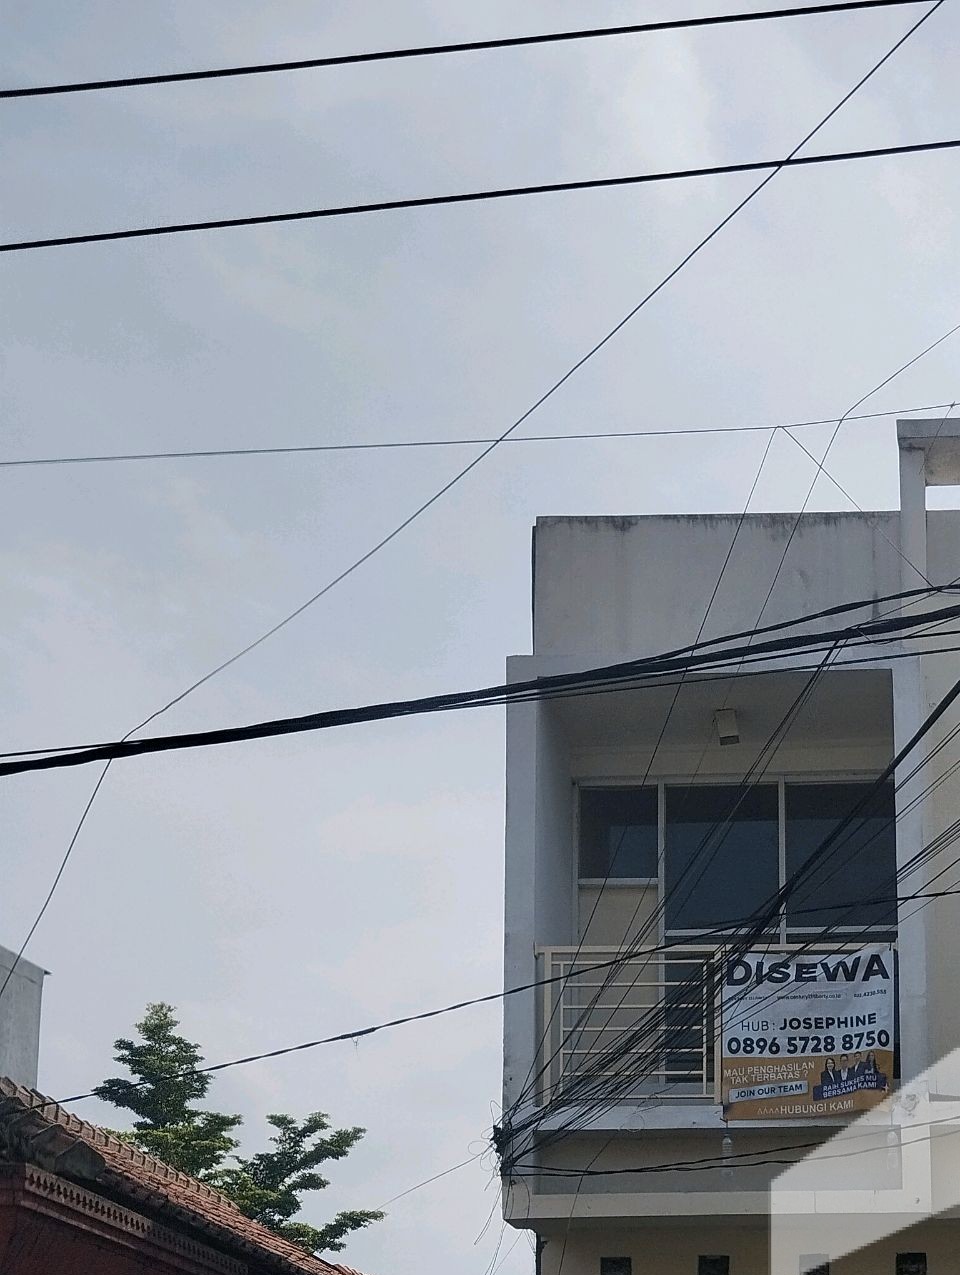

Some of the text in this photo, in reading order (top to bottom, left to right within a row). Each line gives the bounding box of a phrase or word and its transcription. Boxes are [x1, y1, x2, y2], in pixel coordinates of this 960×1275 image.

[726, 953, 890, 986] DISEWA
[779, 1013, 877, 1031] JOSEPHINE
[727, 1030, 890, 1055] 0896 5728 8750
[724, 1061, 815, 1078] MAU PENGHASILAN
[731, 1075, 749, 1085] TAK
[751, 1071, 800, 1083] TERBATAS
[866, 1074, 877, 1082] MU
[735, 1083, 803, 1099] JOIN OUR TEAM
[823, 1081, 877, 1098] BERSAMA KAMI
[780, 1099, 854, 1115] HUBUNGI KAMI
